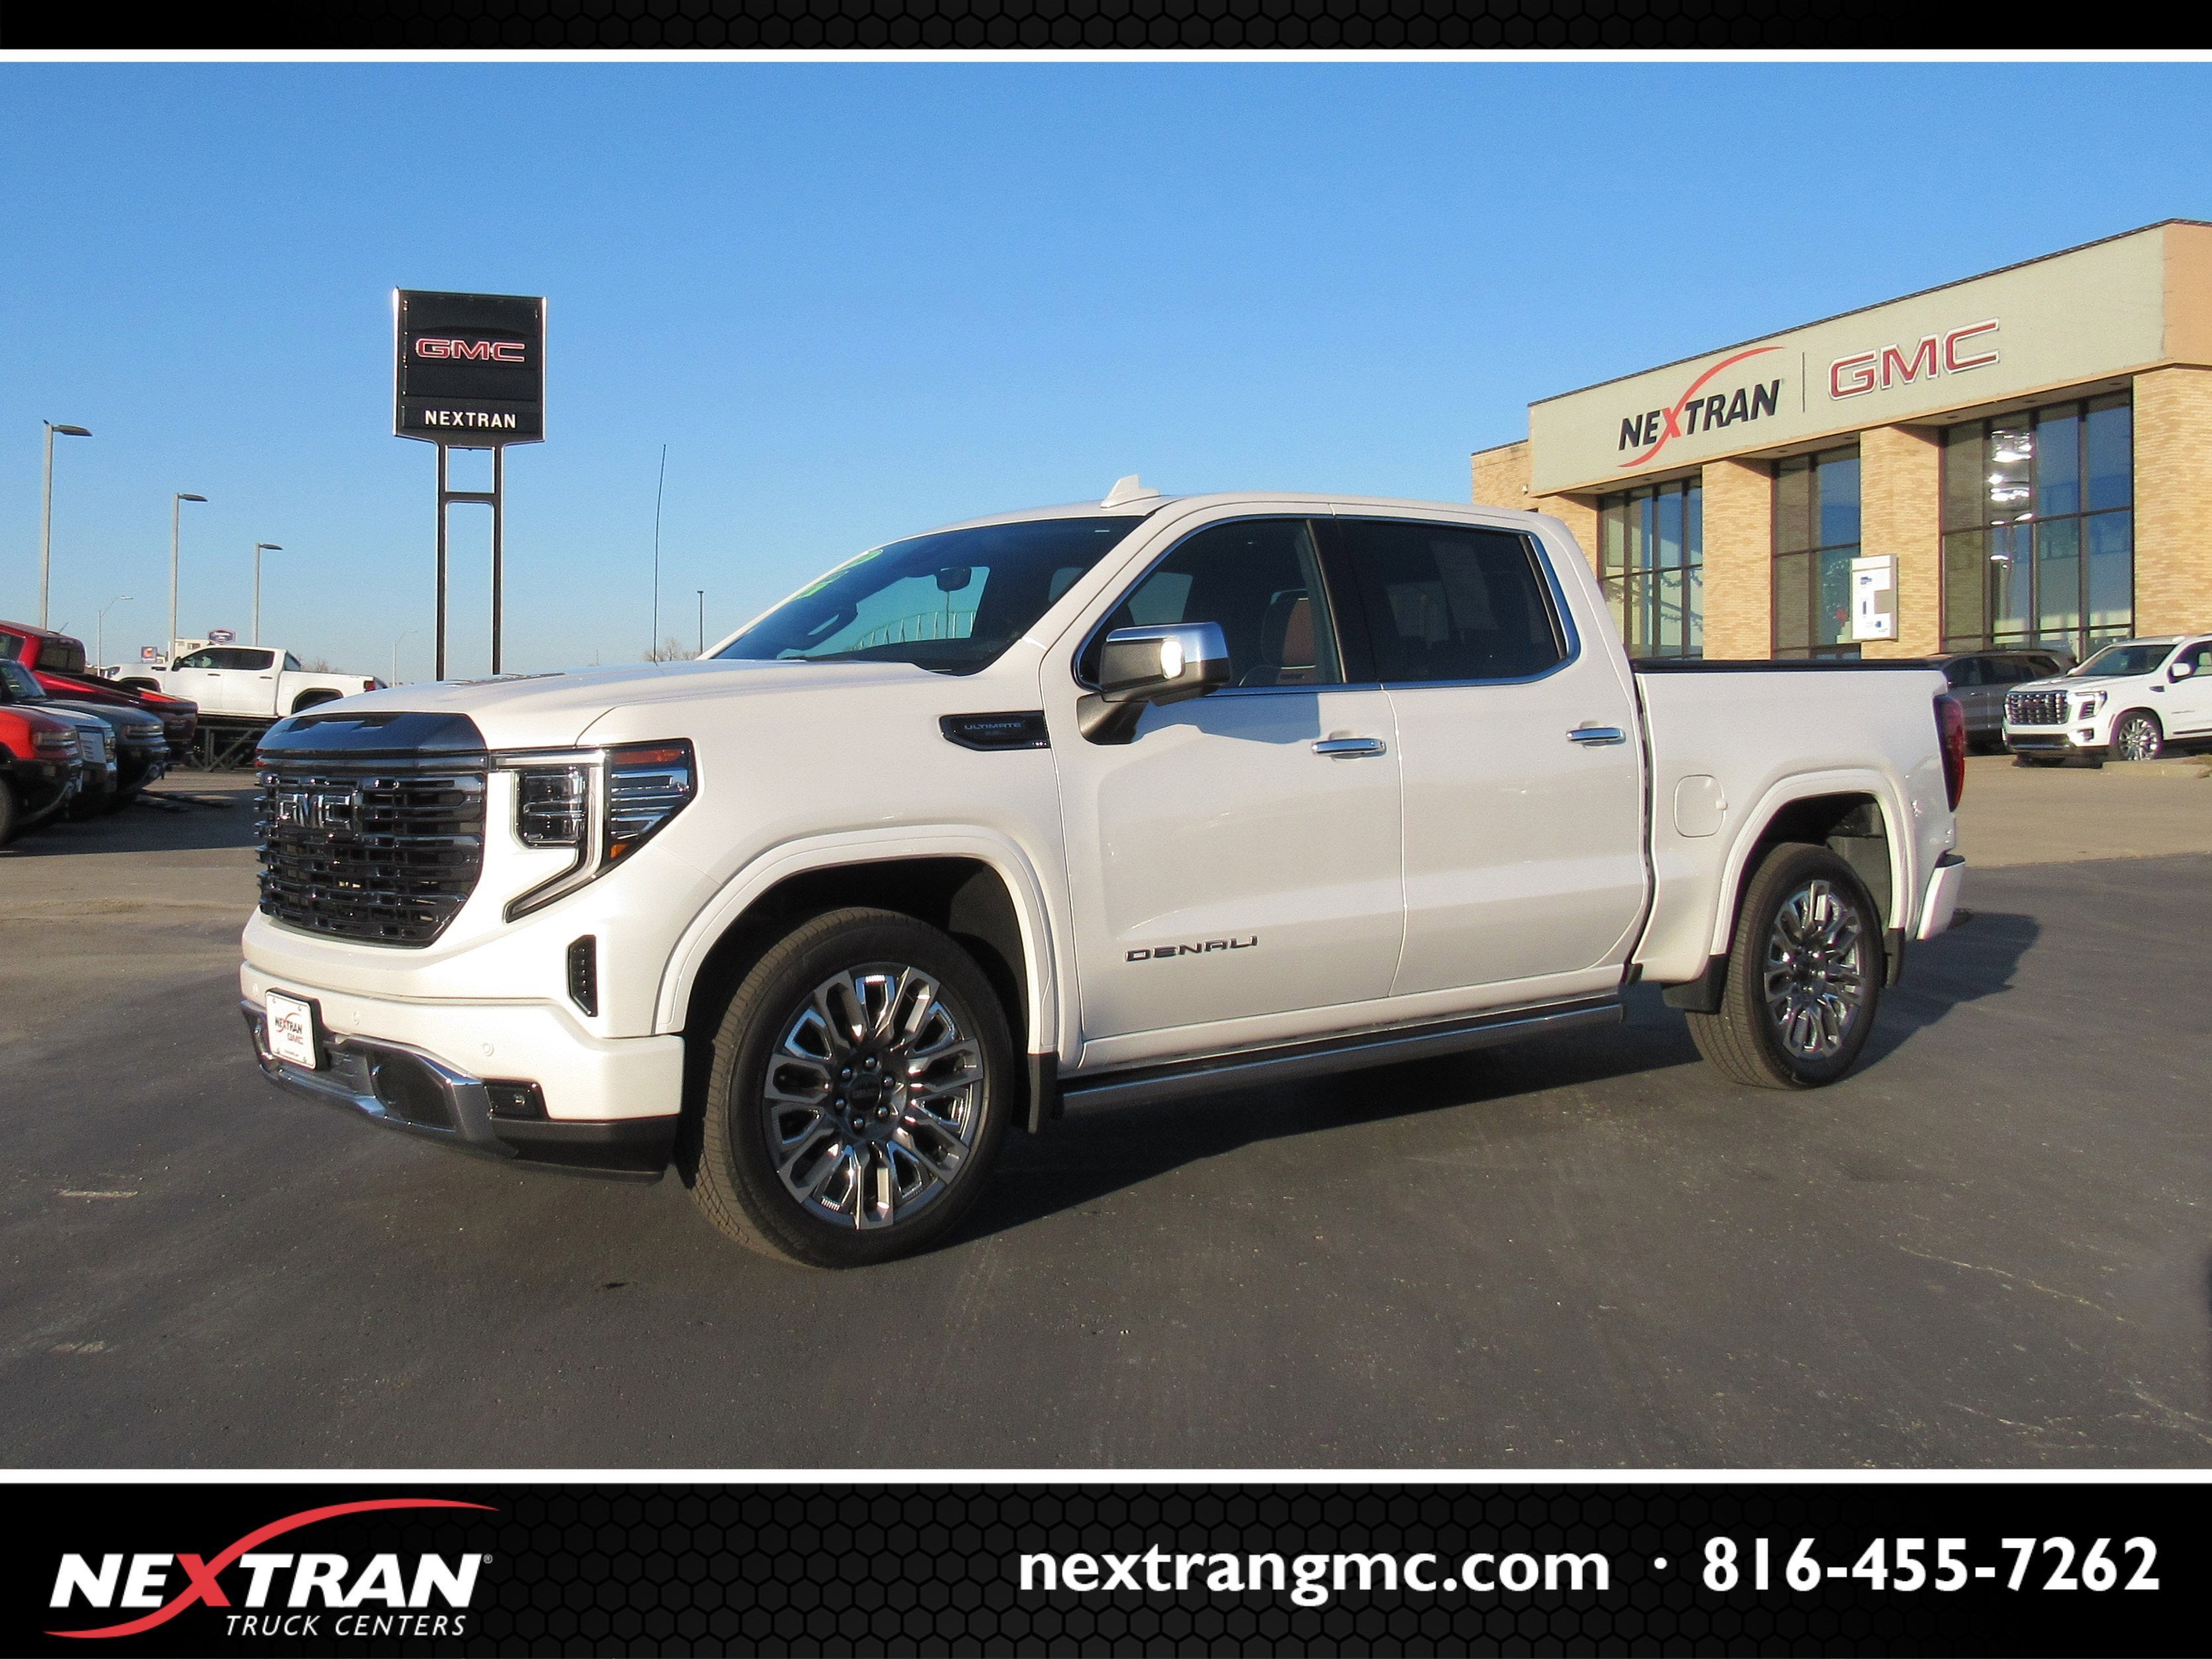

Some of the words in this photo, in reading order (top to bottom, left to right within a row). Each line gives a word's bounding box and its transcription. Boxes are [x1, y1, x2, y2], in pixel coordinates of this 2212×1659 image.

[415, 338, 525, 362] GMC
[1829, 317, 1999, 401] GMC
[425, 410, 516, 428] NEXTRAN
[1618, 378, 1781, 451] NEXTRAN
[276, 793, 351, 830] GMC
[1125, 935, 1258, 962] DENALI
